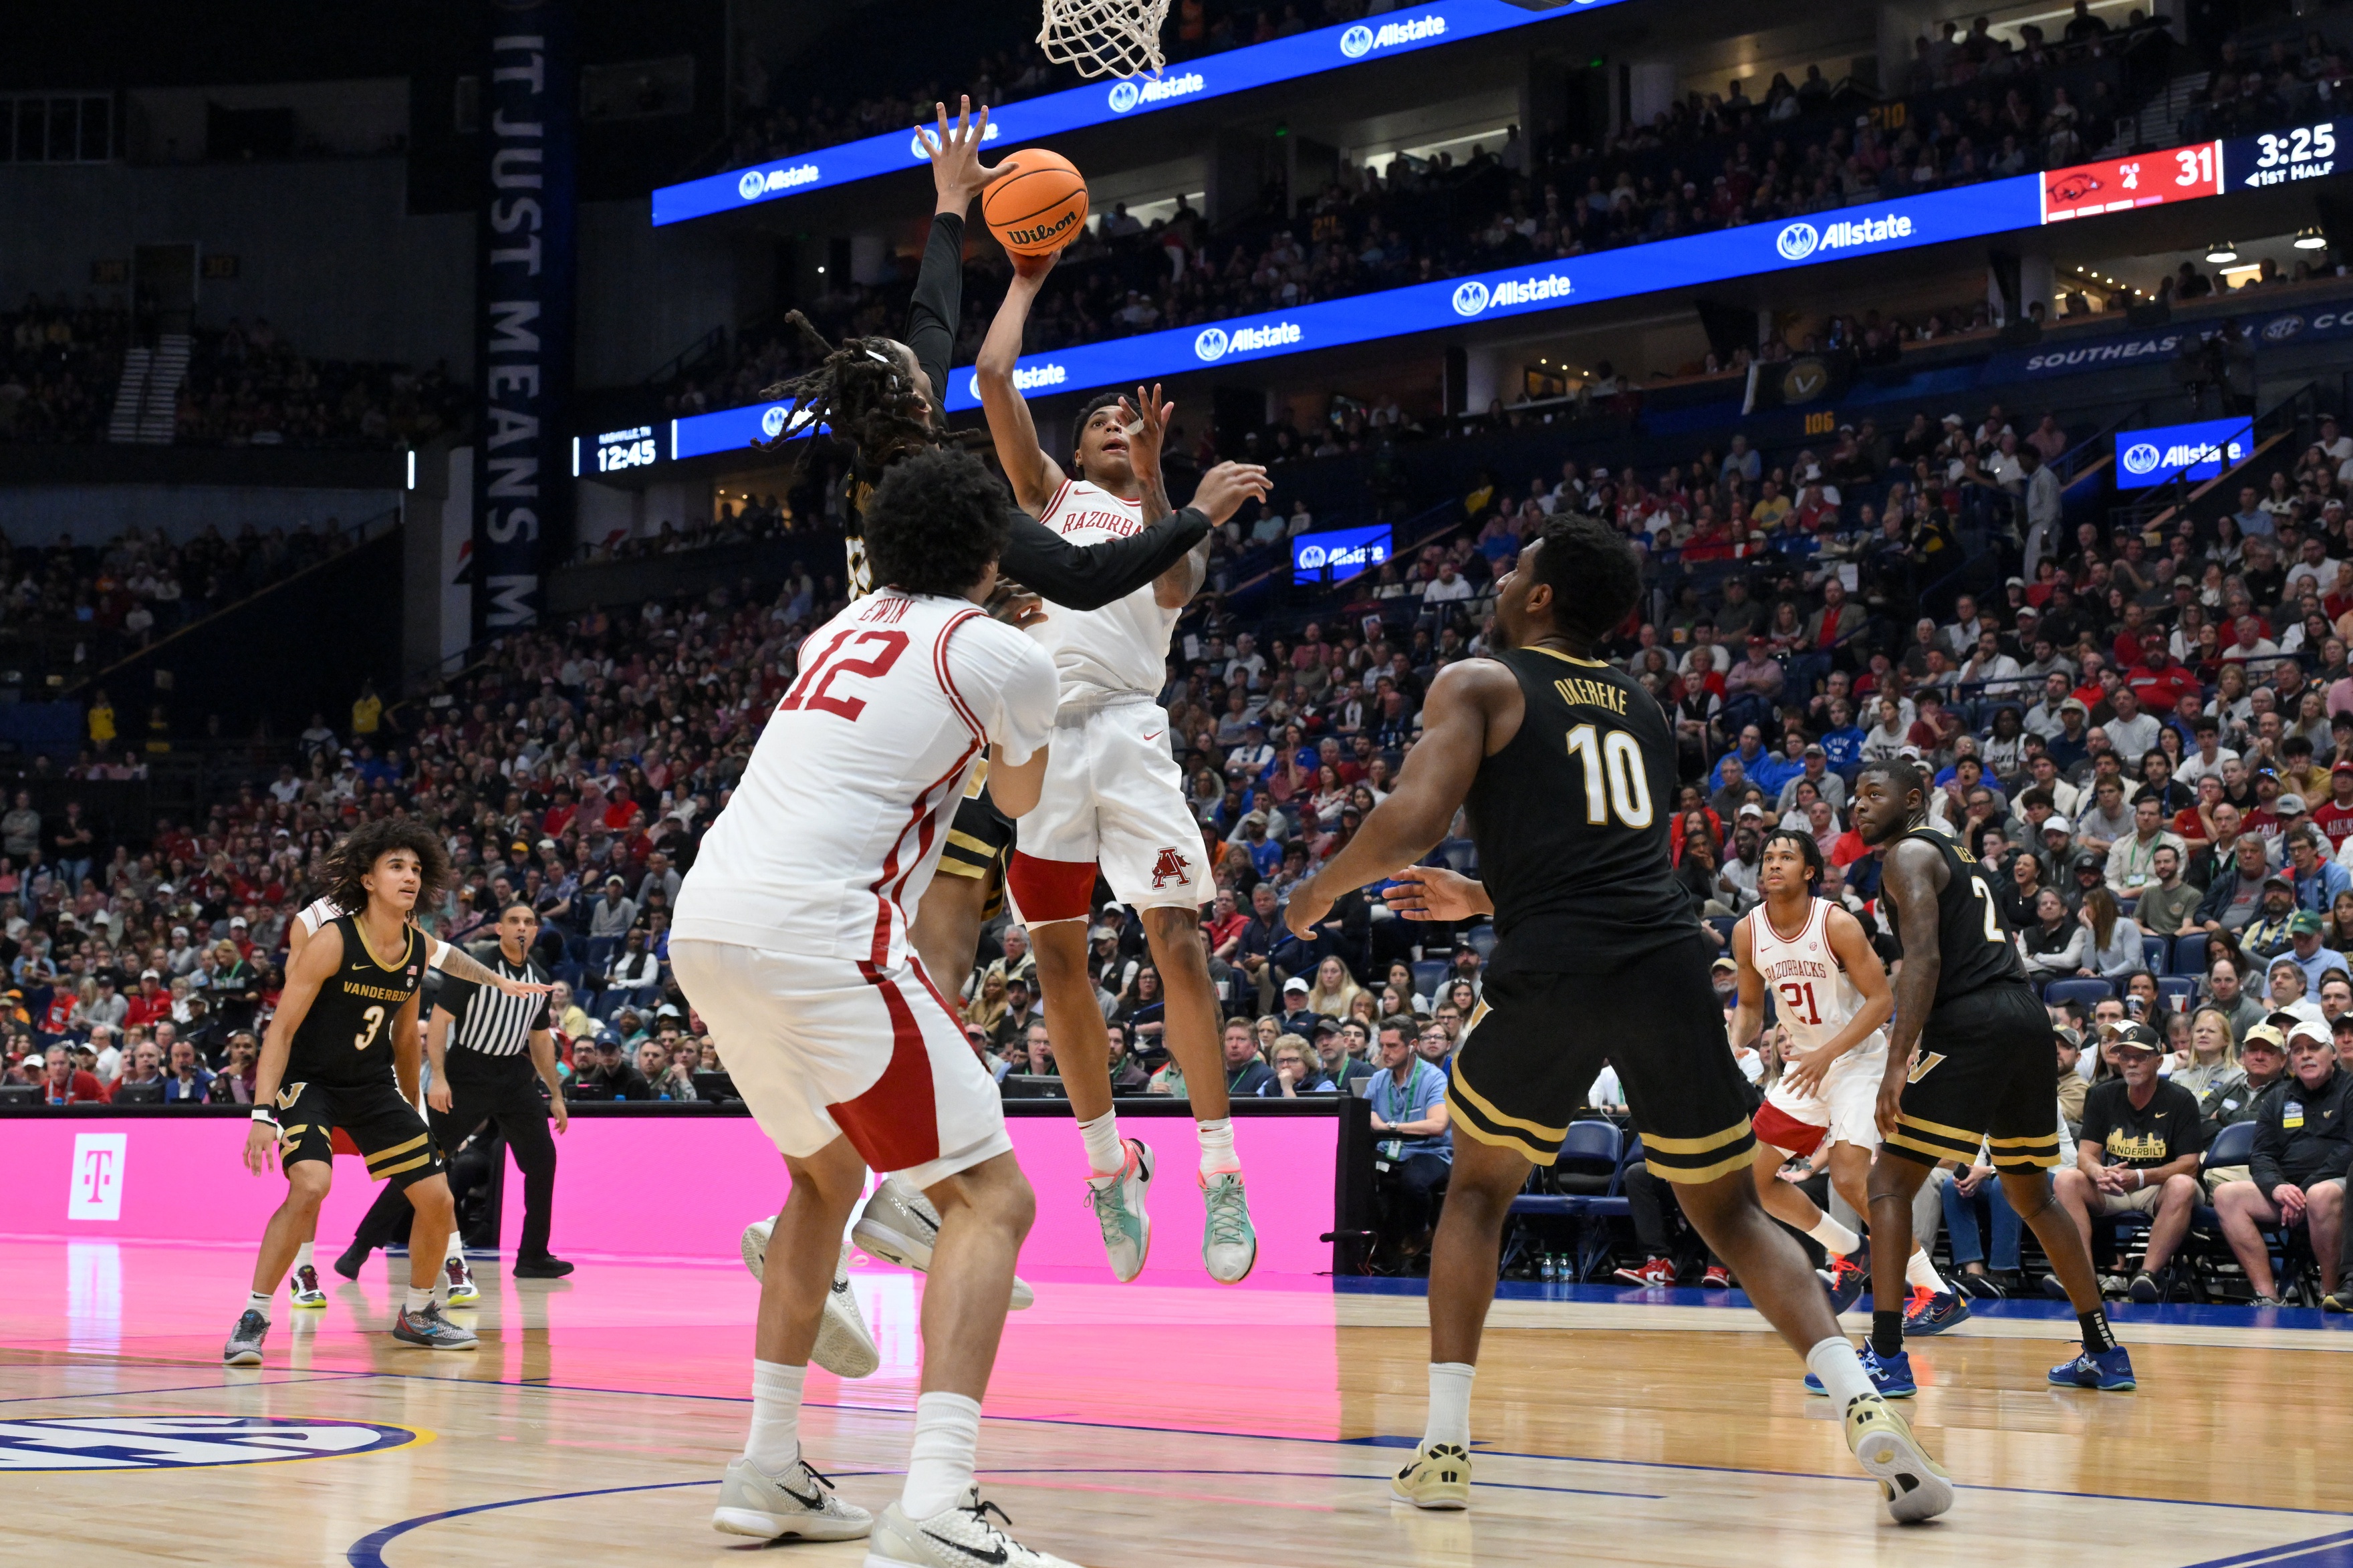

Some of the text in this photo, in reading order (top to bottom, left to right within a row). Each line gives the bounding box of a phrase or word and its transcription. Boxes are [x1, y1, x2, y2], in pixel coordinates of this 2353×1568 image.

[1372, 15, 1445, 49] Allstate
[493, 35, 544, 94] IT
[1137, 72, 1203, 104] Allstate
[2256, 123, 2336, 167] 3:25
[763, 164, 819, 192] Allstate
[2122, 174, 2138, 189] 4
[2175, 146, 2213, 186] 31
[2259, 161, 2334, 185] 1ST HALF
[489, 107, 543, 277] JUST
[1007, 211, 1077, 245] Wilson
[1818, 214, 1912, 251] Allstate
[1489, 274, 1570, 308] Allstate
[1227, 321, 1300, 354] Allstate
[1012, 364, 1066, 390] llstate
[486, 301, 539, 543] MEANS
[1805, 410, 1834, 435] 106
[598, 439, 656, 472] 12:45
[2160, 442, 2241, 468] Allstae
[1062, 511, 1144, 537] RAZORBA
[858, 598, 915, 624] EWIN
[778, 629, 910, 722] 12
[1554, 678, 1627, 715] OKEREKE
[1566, 723, 1653, 829] 10
[1971, 876, 2006, 943] 2
[1765, 960, 1826, 983] RAZORBACKS
[1779, 983, 1822, 1025] 21
[354, 1005, 384, 1051] 3
[2108, 1144, 2164, 1156] VANDERBILT
[84, 1150, 112, 1202] T
